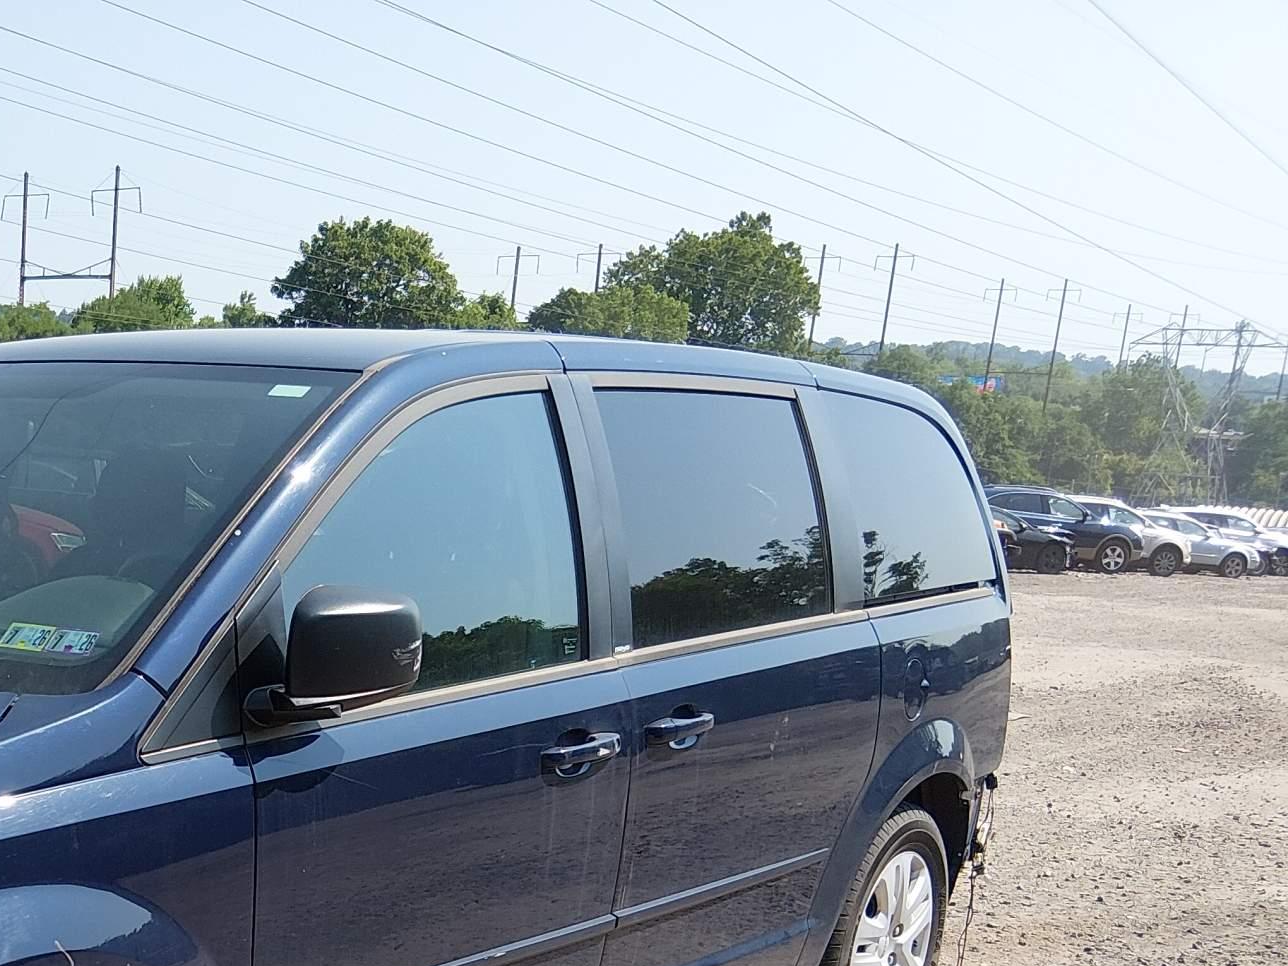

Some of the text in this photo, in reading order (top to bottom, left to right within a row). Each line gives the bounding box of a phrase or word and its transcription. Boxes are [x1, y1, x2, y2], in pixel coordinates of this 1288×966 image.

[5, 629, 51, 647] 7 26
[51, 634, 98, 652] 7 26
